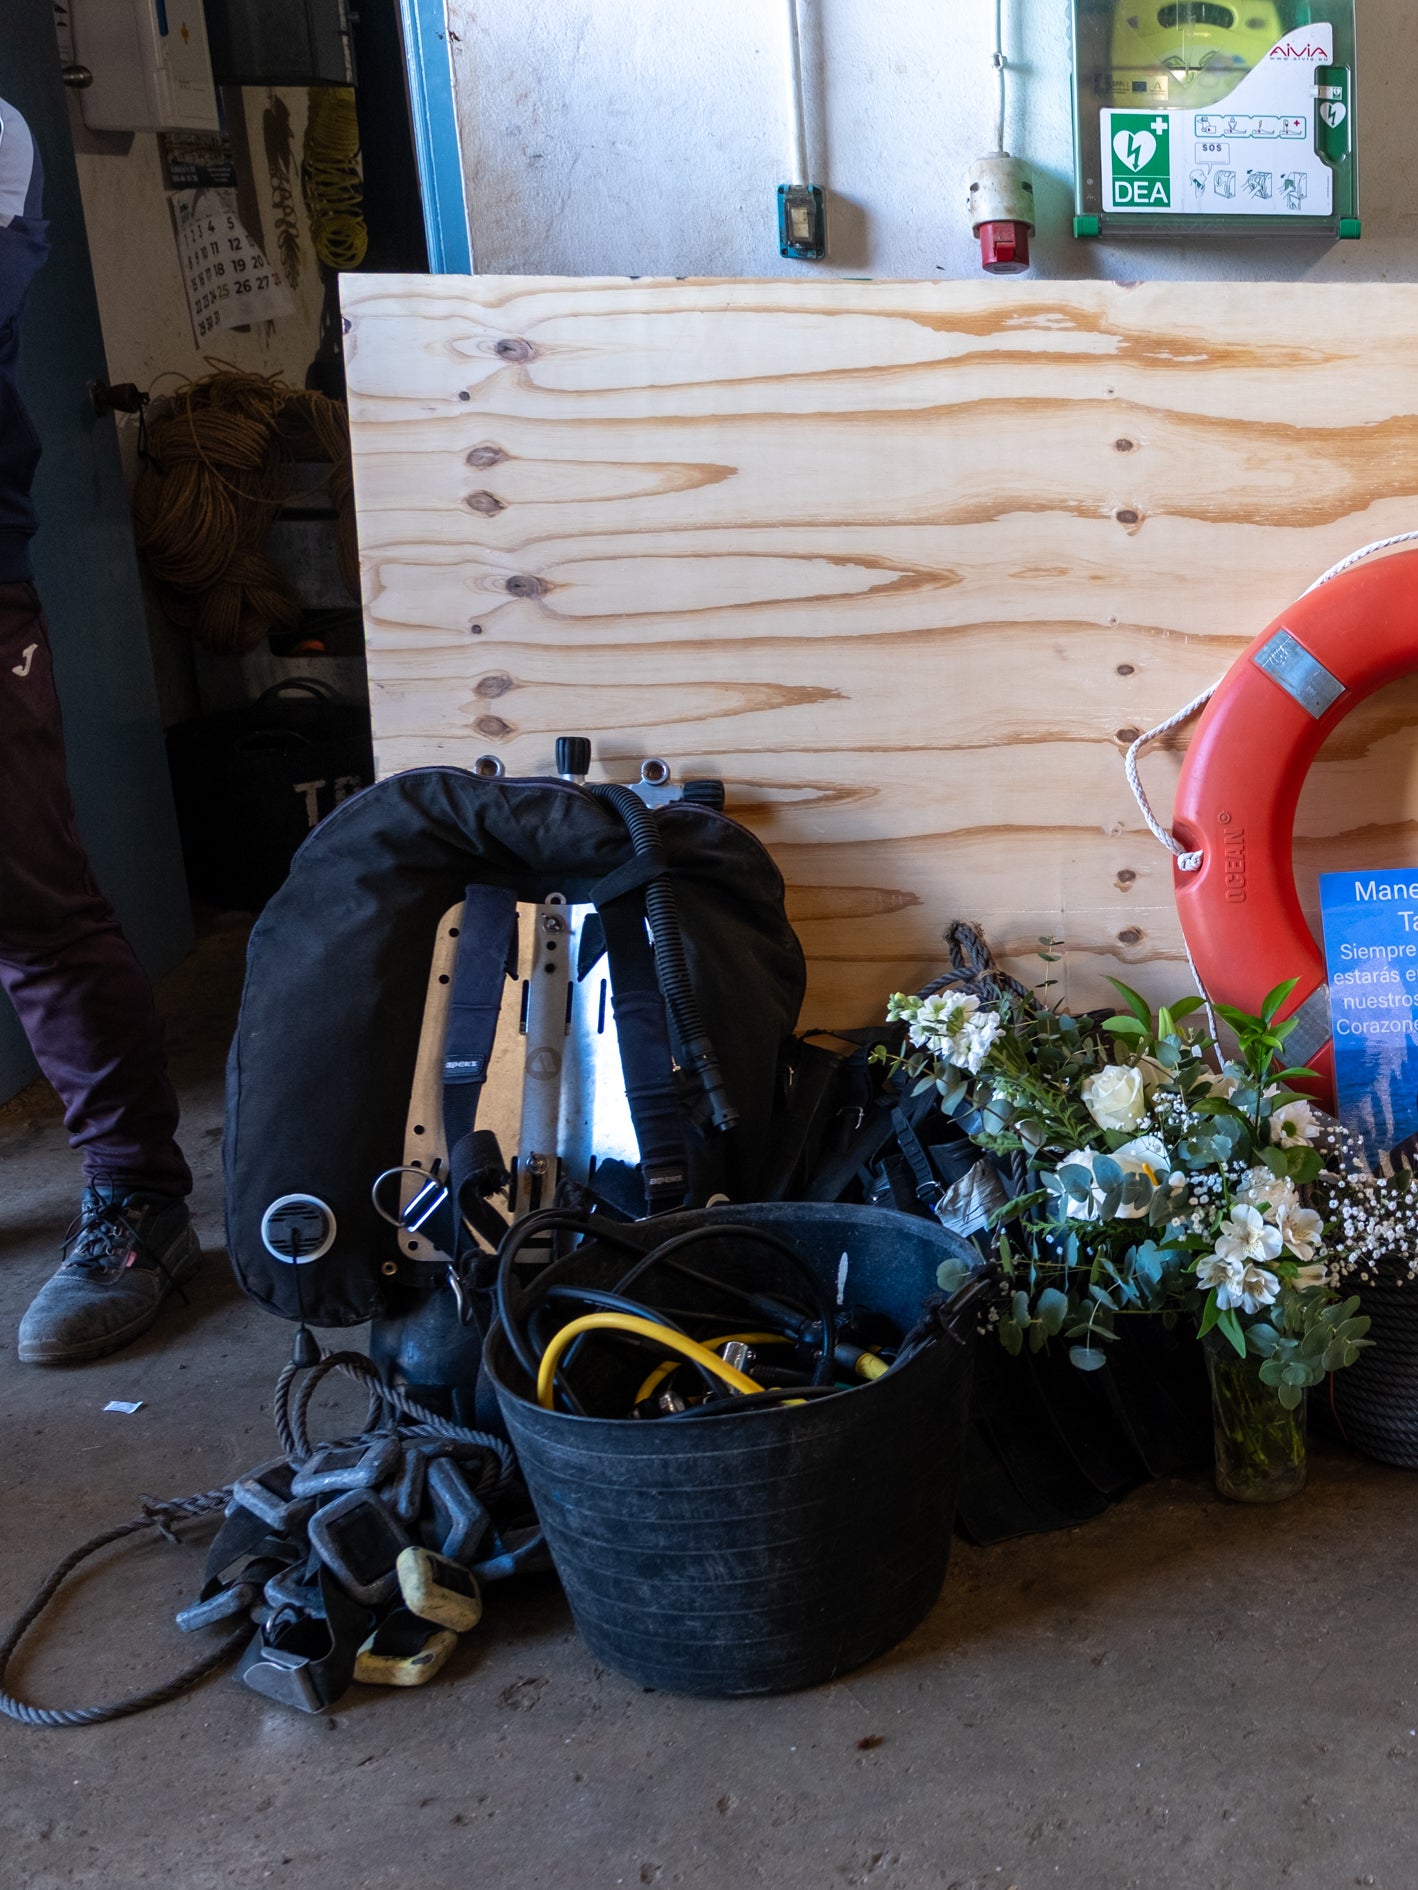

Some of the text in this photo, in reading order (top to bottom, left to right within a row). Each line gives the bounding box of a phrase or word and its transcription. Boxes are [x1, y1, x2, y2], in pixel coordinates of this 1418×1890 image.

[1202, 143, 1222, 152] SOS
[1115, 181, 1169, 203] DEA
[208, 220, 215, 232] 4
[227, 216, 234, 230] 5
[210, 241, 219, 255] 11
[228, 238, 242, 252] 12
[213, 262, 225, 276] 18
[232, 258, 246, 273] 19
[251, 255, 264, 269] 20
[218, 283, 230, 299] 25
[234, 279, 252, 294] 26
[256, 275, 269, 290] 27
[1224, 828, 1247, 903] OCEAN
[1340, 943, 1417, 961] Siempre
[1333, 966, 1400, 985] estarás
